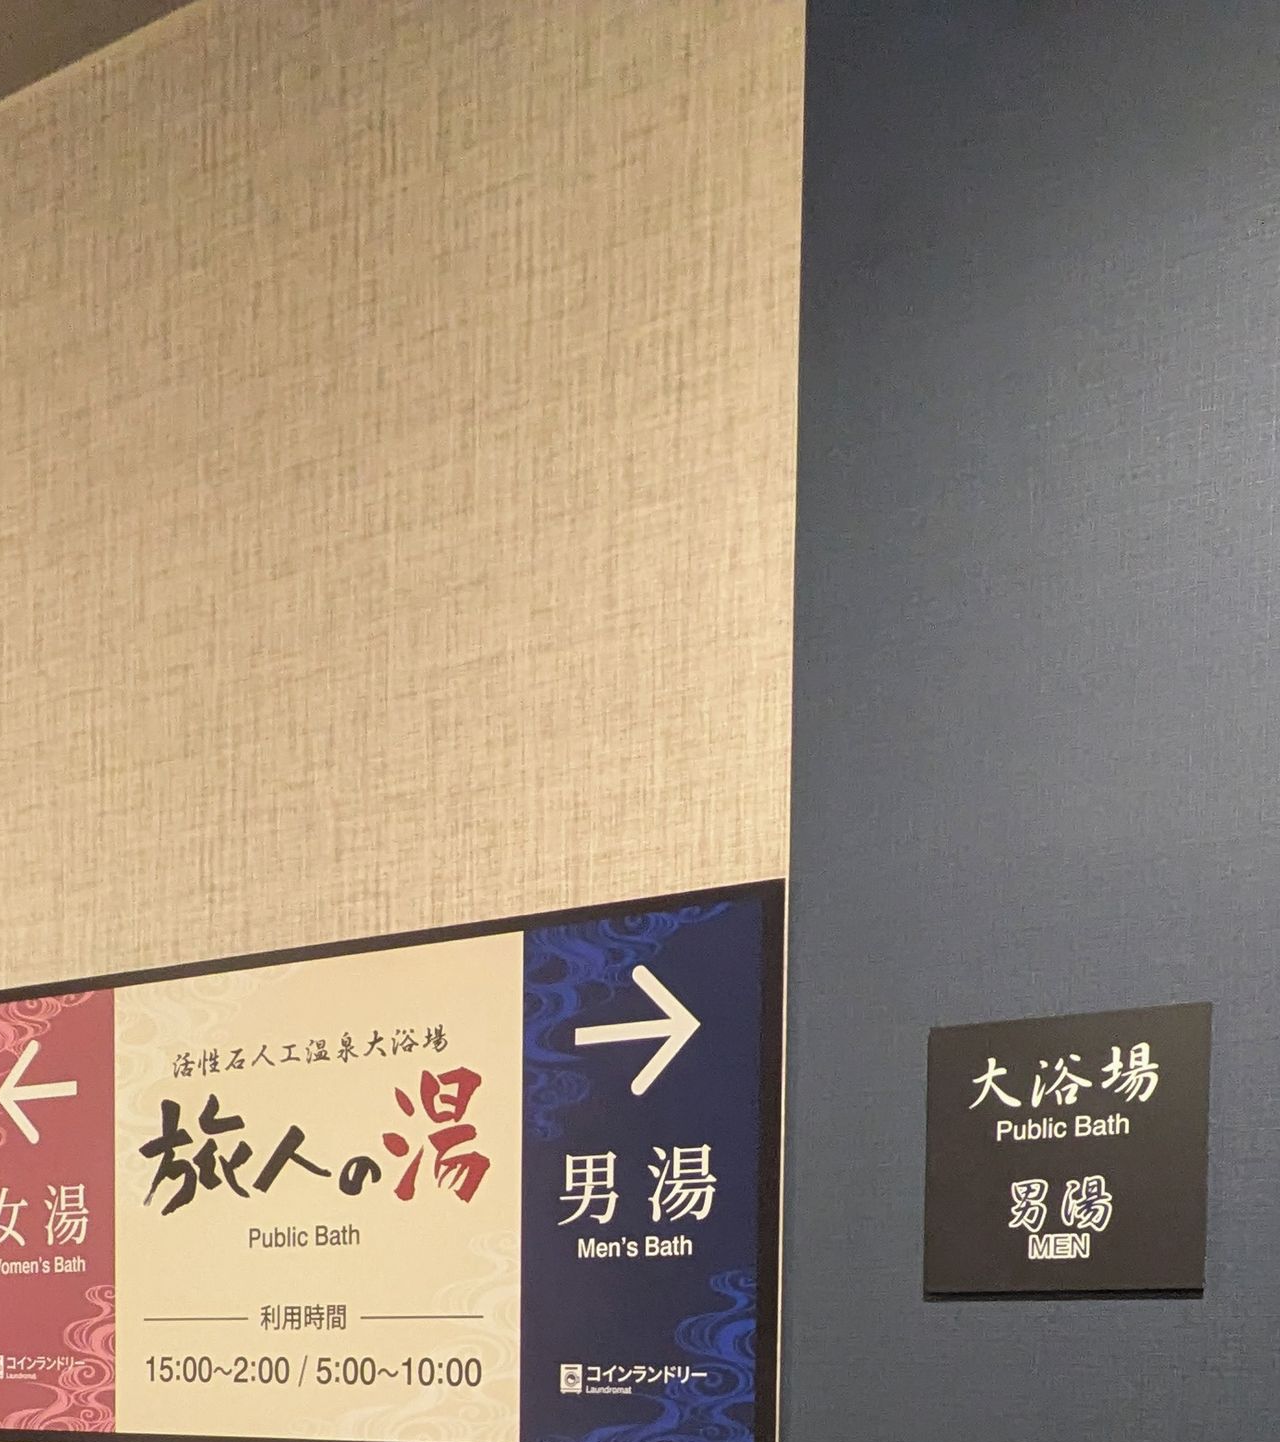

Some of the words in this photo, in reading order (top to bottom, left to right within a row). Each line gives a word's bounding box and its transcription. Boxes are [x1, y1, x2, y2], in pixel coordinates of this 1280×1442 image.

[172, 1023, 449, 1079] 活性石人工温泉大浴場
[968, 1041, 1160, 1110] 大浴場
[138, 1066, 491, 1216] 旅人の湯
[996, 1118, 1068, 1142] Public
[1074, 1112, 1130, 1137] Bath
[558, 1143, 717, 1226] 男湯
[1008, 1173, 1113, 1233] 男湯
[248, 1225, 309, 1249] Public
[315, 1223, 361, 1246] Bath
[577, 1236, 639, 1259] Men's
[644, 1234, 693, 1257] Bath
[1028, 1232, 1091, 1260] MEN
[54, 1255, 86, 1274] Bath
[260, 1303, 347, 1331] 利用時間
[6, 1354, 86, 1371] コインランドリー
[587, 1364, 708, 1384] コインランドリー
